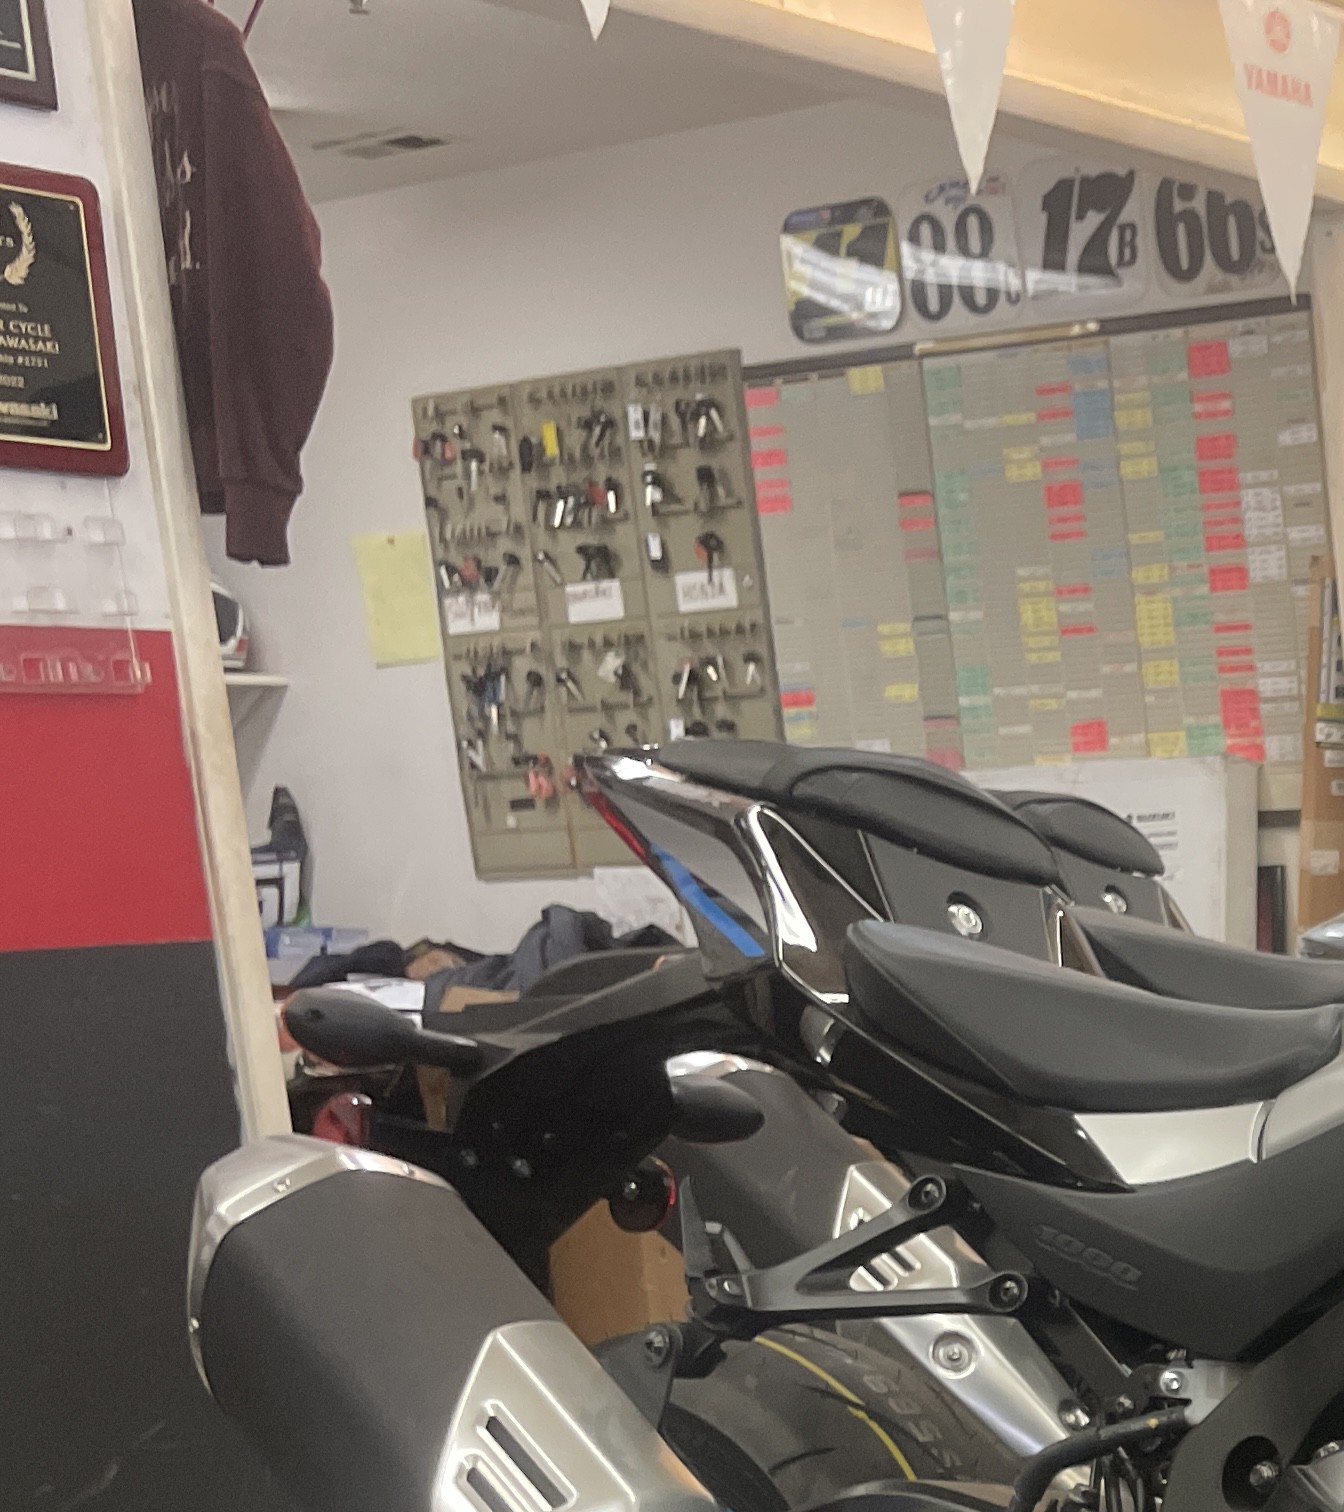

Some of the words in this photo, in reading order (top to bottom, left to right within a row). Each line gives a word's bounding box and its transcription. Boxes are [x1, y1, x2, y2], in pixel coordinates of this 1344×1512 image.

[1243, 62, 1313, 108] YAMAHA
[9, 319, 52, 338] CYCLE
[0, 334, 59, 355] AWASAKI
